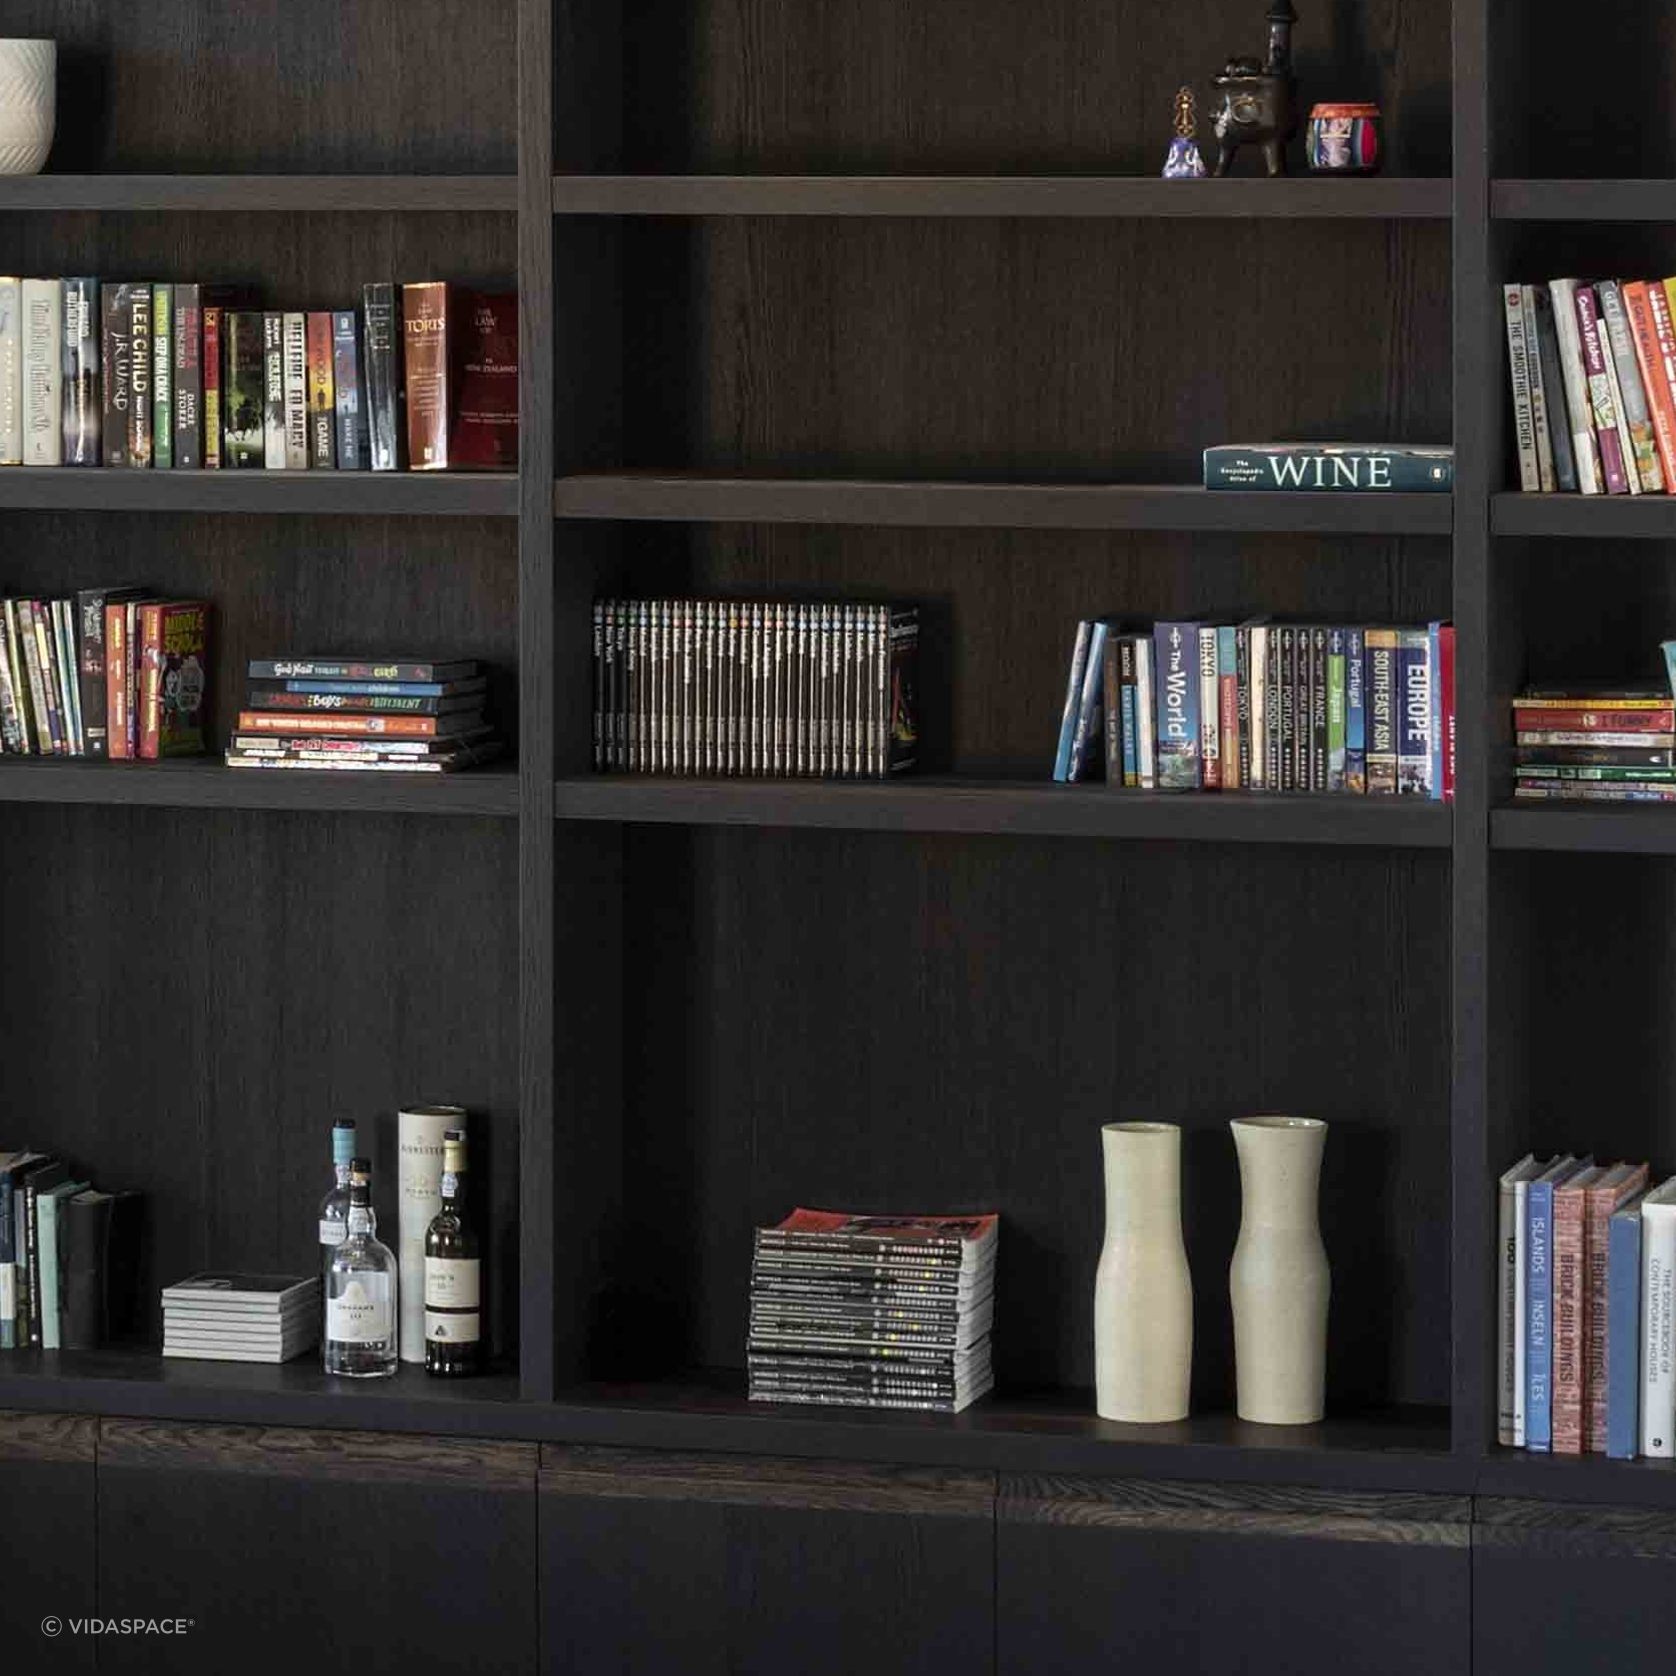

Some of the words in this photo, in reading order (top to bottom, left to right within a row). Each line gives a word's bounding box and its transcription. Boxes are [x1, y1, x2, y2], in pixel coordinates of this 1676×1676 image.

[132, 303, 146, 335] LEE
[1510, 320, 1522, 341] THE
[112, 358, 129, 411] WARD
[132, 338, 147, 392] CHILD
[1512, 345, 1528, 399] SMOOTHIE
[178, 388, 187, 430] STOKER
[1517, 403, 1532, 451] KITCHEN
[317, 422, 328, 457] GAME
[1267, 456, 1392, 487] WINE
[1122, 646, 1130, 677] MOON
[1171, 650, 1181, 671] The
[1200, 634, 1215, 678] TOKYO
[1167, 671, 1187, 738] World
[1238, 685, 1248, 720] TOKYO
[1267, 684, 1278, 730] LONDON
[1315, 684, 1325, 728] FRANCE
[1331, 685, 1343, 724] Japan
[1350, 659, 1362, 708] Portugal
[1373, 650, 1389, 722] SOUTH-EAST
[1408, 664, 1428, 742] EUROPE
[1282, 684, 1293, 742] PORTUGAL
[1374, 723, 1389, 751] ASIA
[1531, 1216, 1546, 1273] ISLANDS
[1561, 1253, 1575, 1300] BRICK
[1592, 1252, 1606, 1300] BRICK
[1648, 1258, 1660, 1341] CONTEMPORARY
[1661, 1268, 1672, 1289] THE
[1531, 1299, 1546, 1346] INSELN
[1560, 1302, 1575, 1383] BUILDINGS
[1590, 1302, 1606, 1382] BUILDINGS
[1661, 1290, 1672, 1359] SOURCEBOOK
[1648, 1342, 1660, 1384] HOUSES
